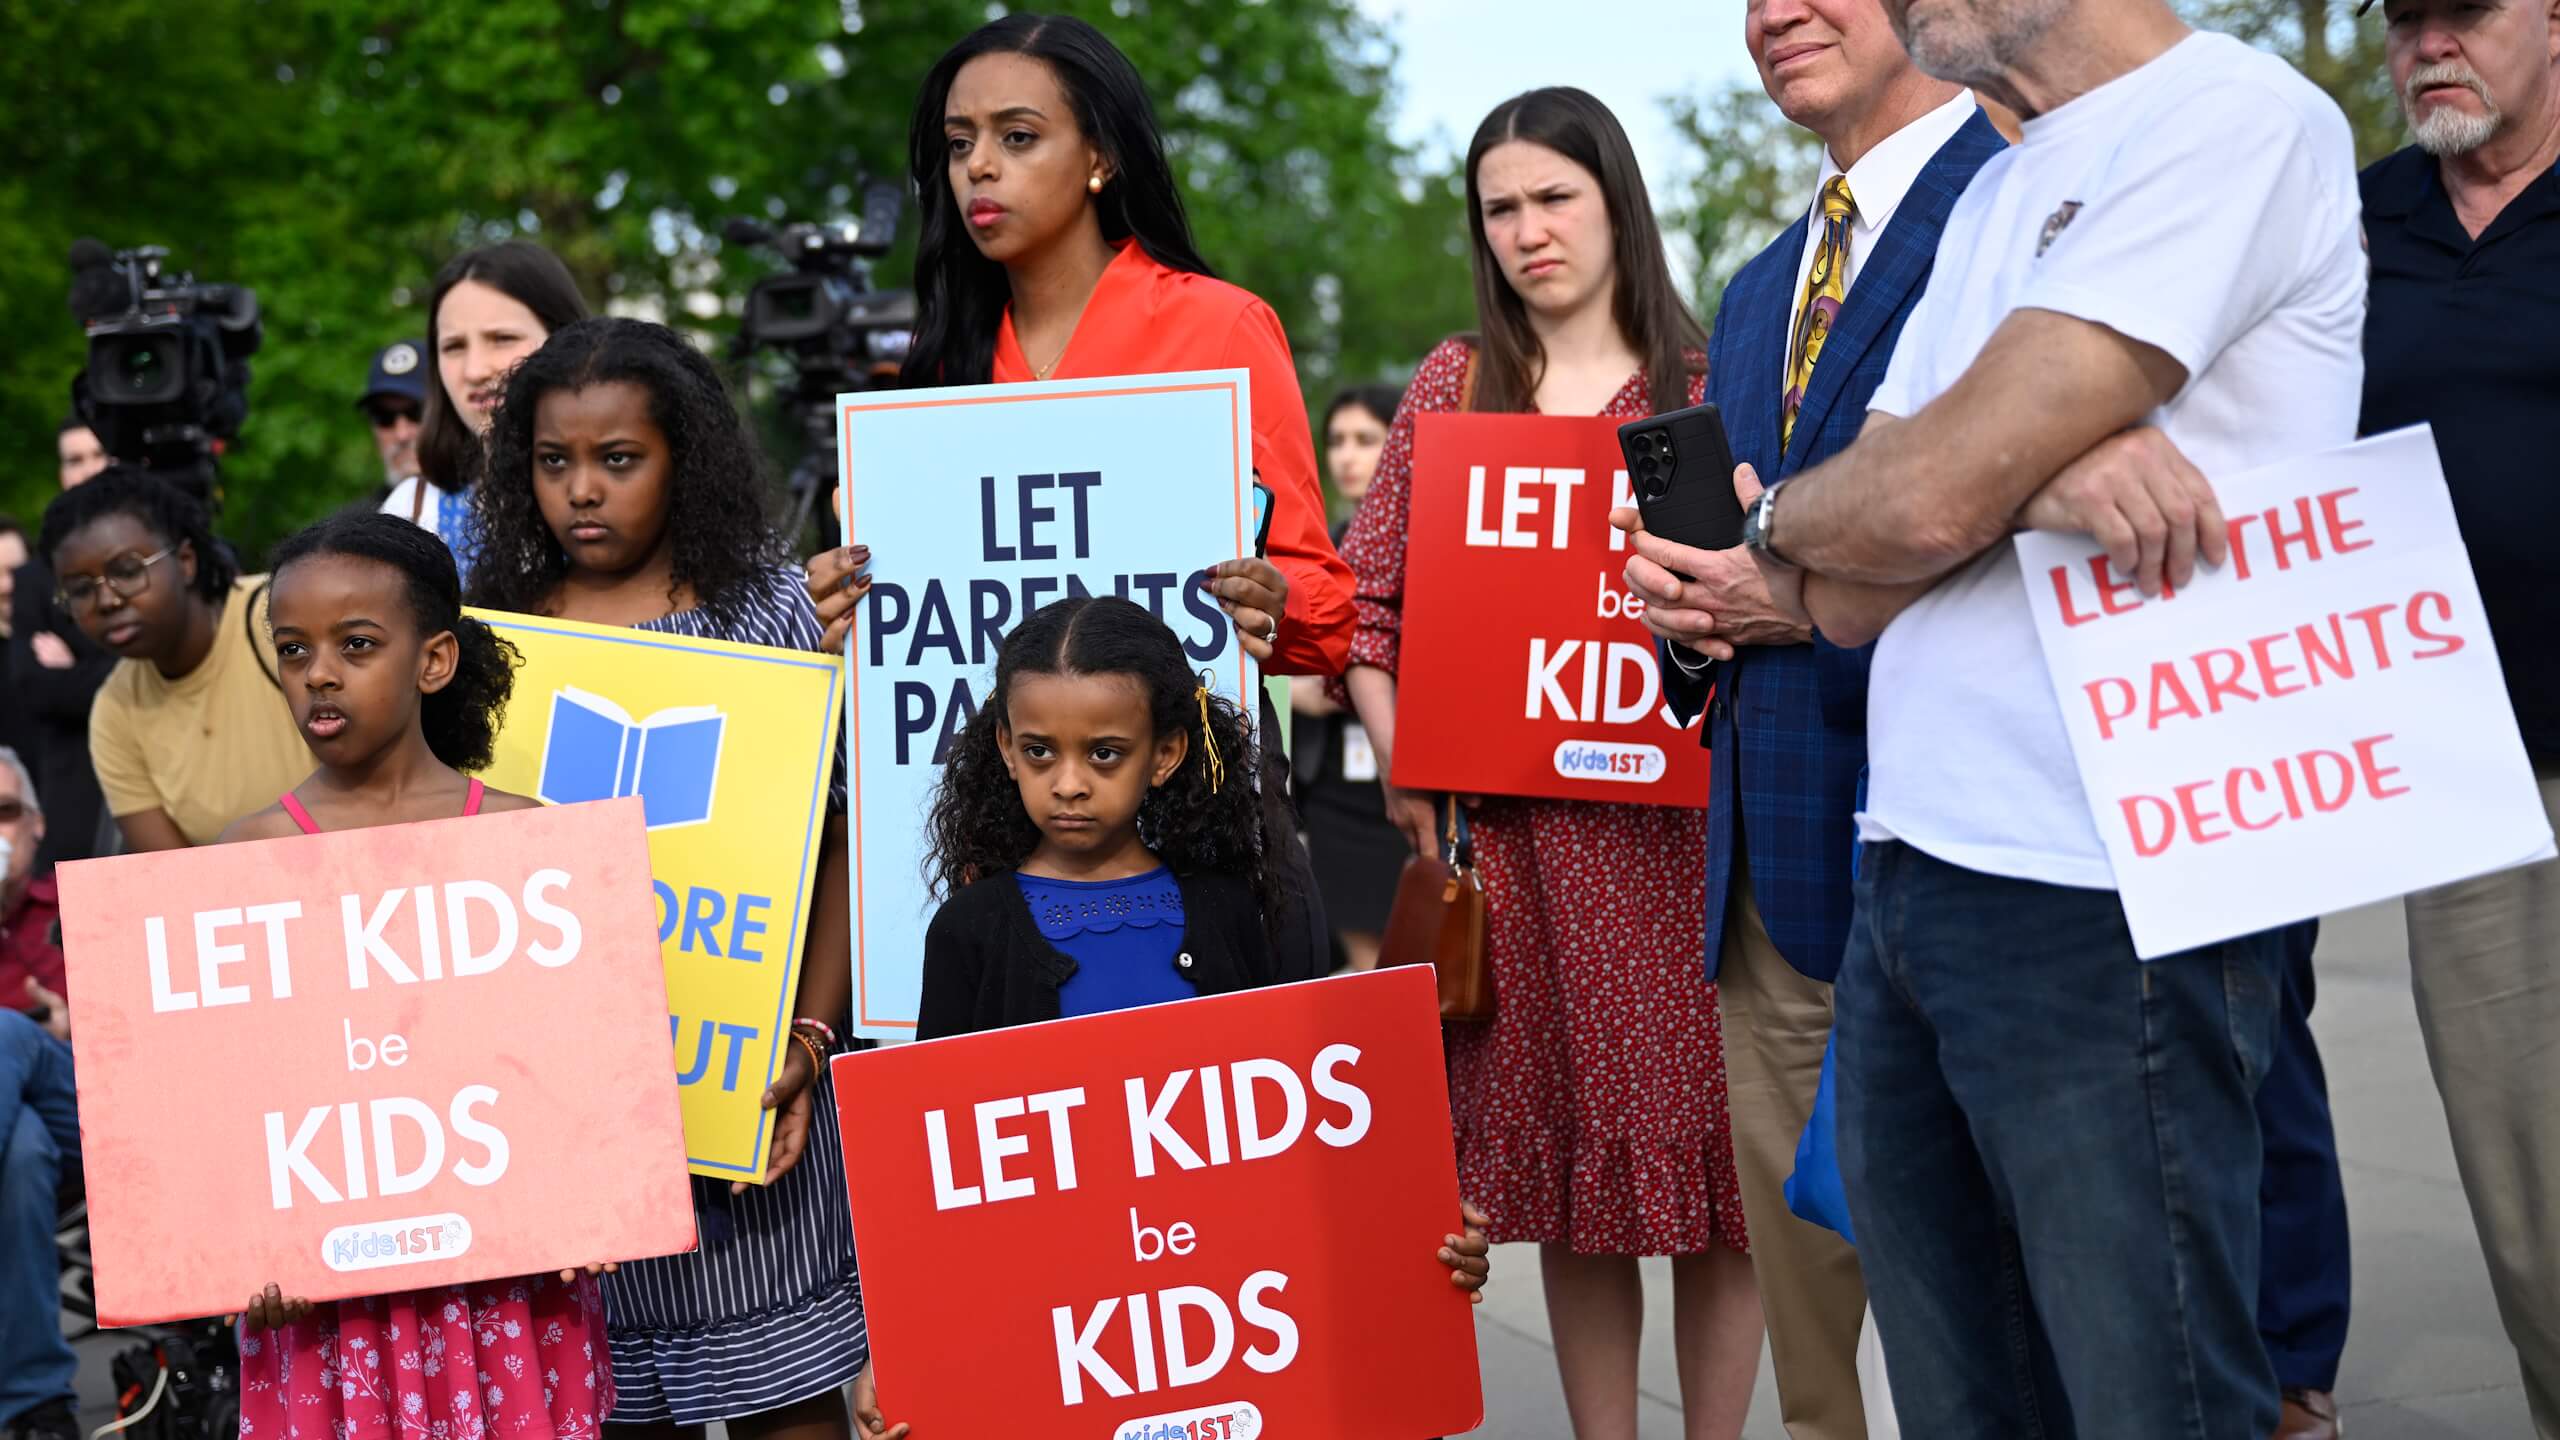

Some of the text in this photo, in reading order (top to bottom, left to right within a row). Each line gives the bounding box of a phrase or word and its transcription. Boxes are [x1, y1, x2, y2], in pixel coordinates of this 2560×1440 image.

[980, 471, 1102, 562] LET
[1465, 466, 1585, 549] LET
[2048, 487, 2375, 628] LE THE
[1597, 572, 1645, 619] be
[2082, 590, 2466, 740] PARENTS
[2117, 733, 2411, 857] DECIDE
[144, 868, 583, 1013] LET KIDS
[343, 1018, 409, 1072] be
[264, 1084, 510, 1210] KIDS
[924, 1043, 1372, 1211] LET KIDS
[1129, 1207, 1197, 1262] be
[1051, 1270, 1299, 1406] KIDS
